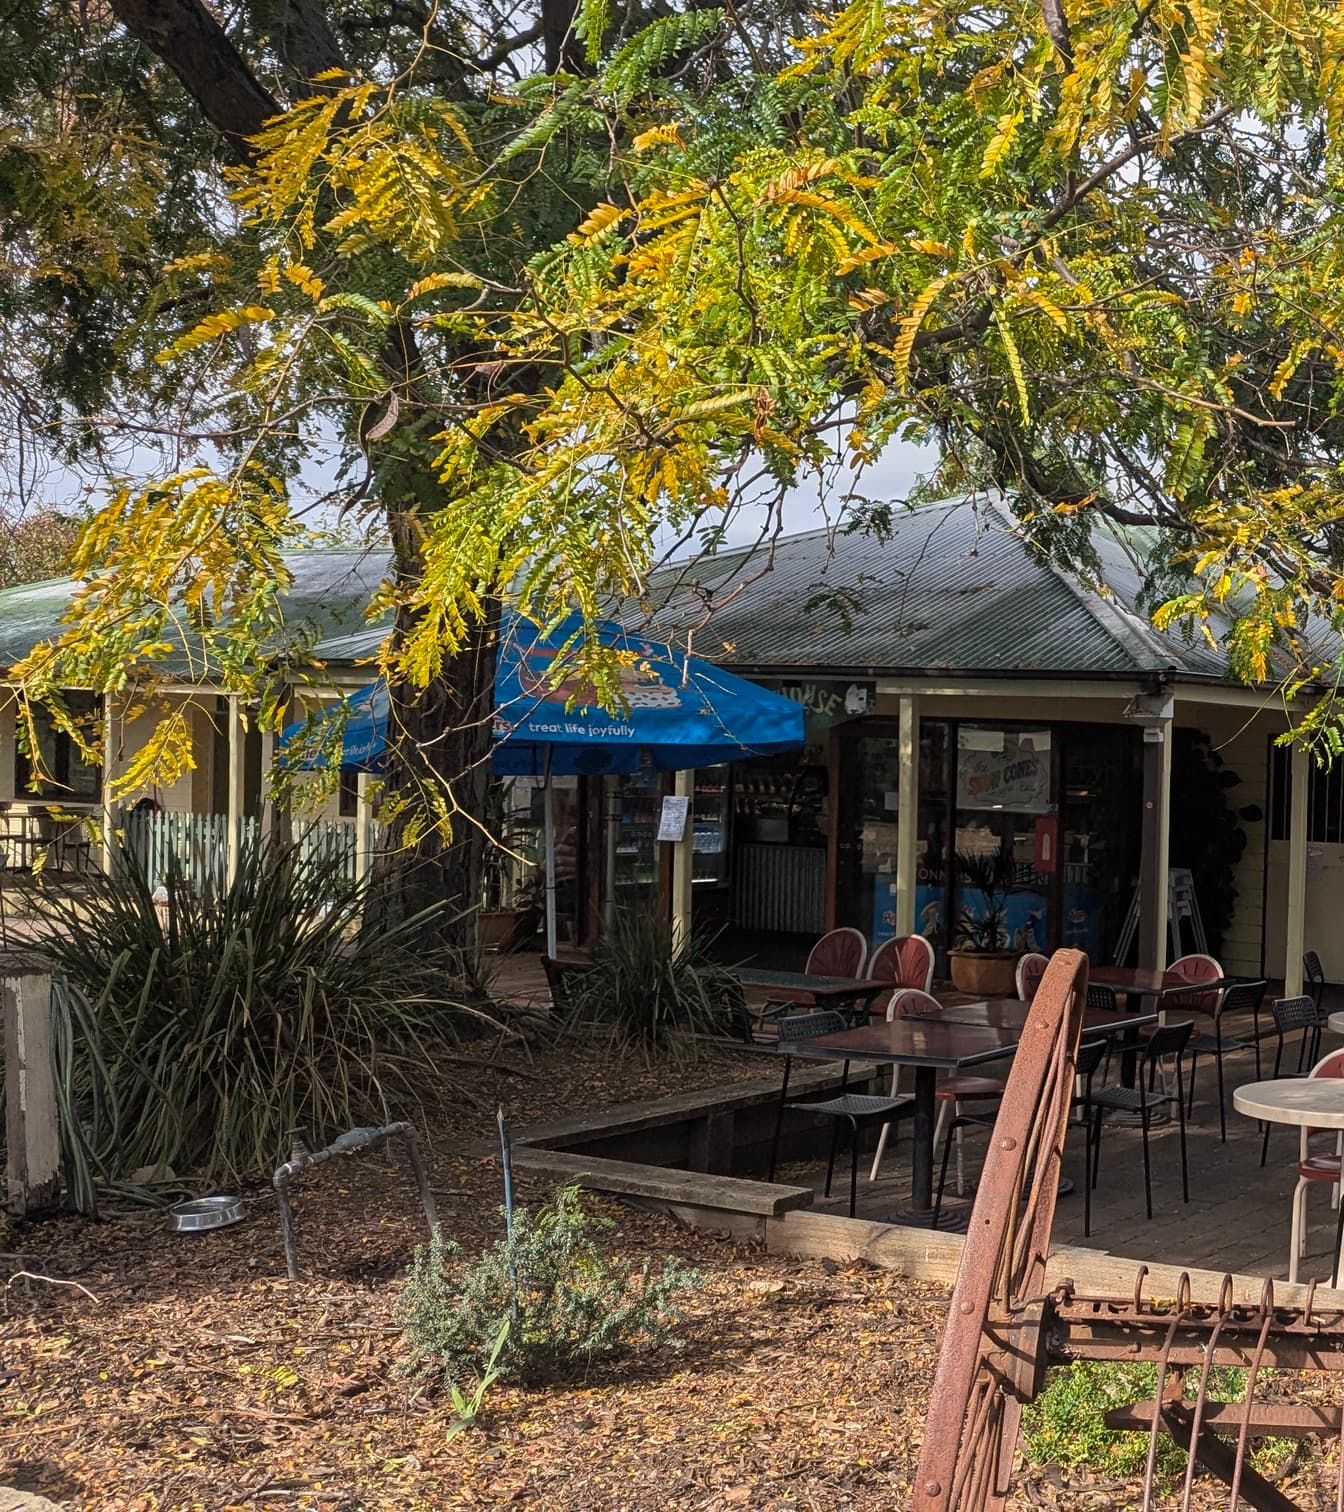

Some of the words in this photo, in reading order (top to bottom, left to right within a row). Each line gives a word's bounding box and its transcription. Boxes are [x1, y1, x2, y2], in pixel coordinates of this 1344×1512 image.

[529, 722, 562, 733] treat
[565, 723, 585, 735] life
[588, 724, 636, 738] joyfully
